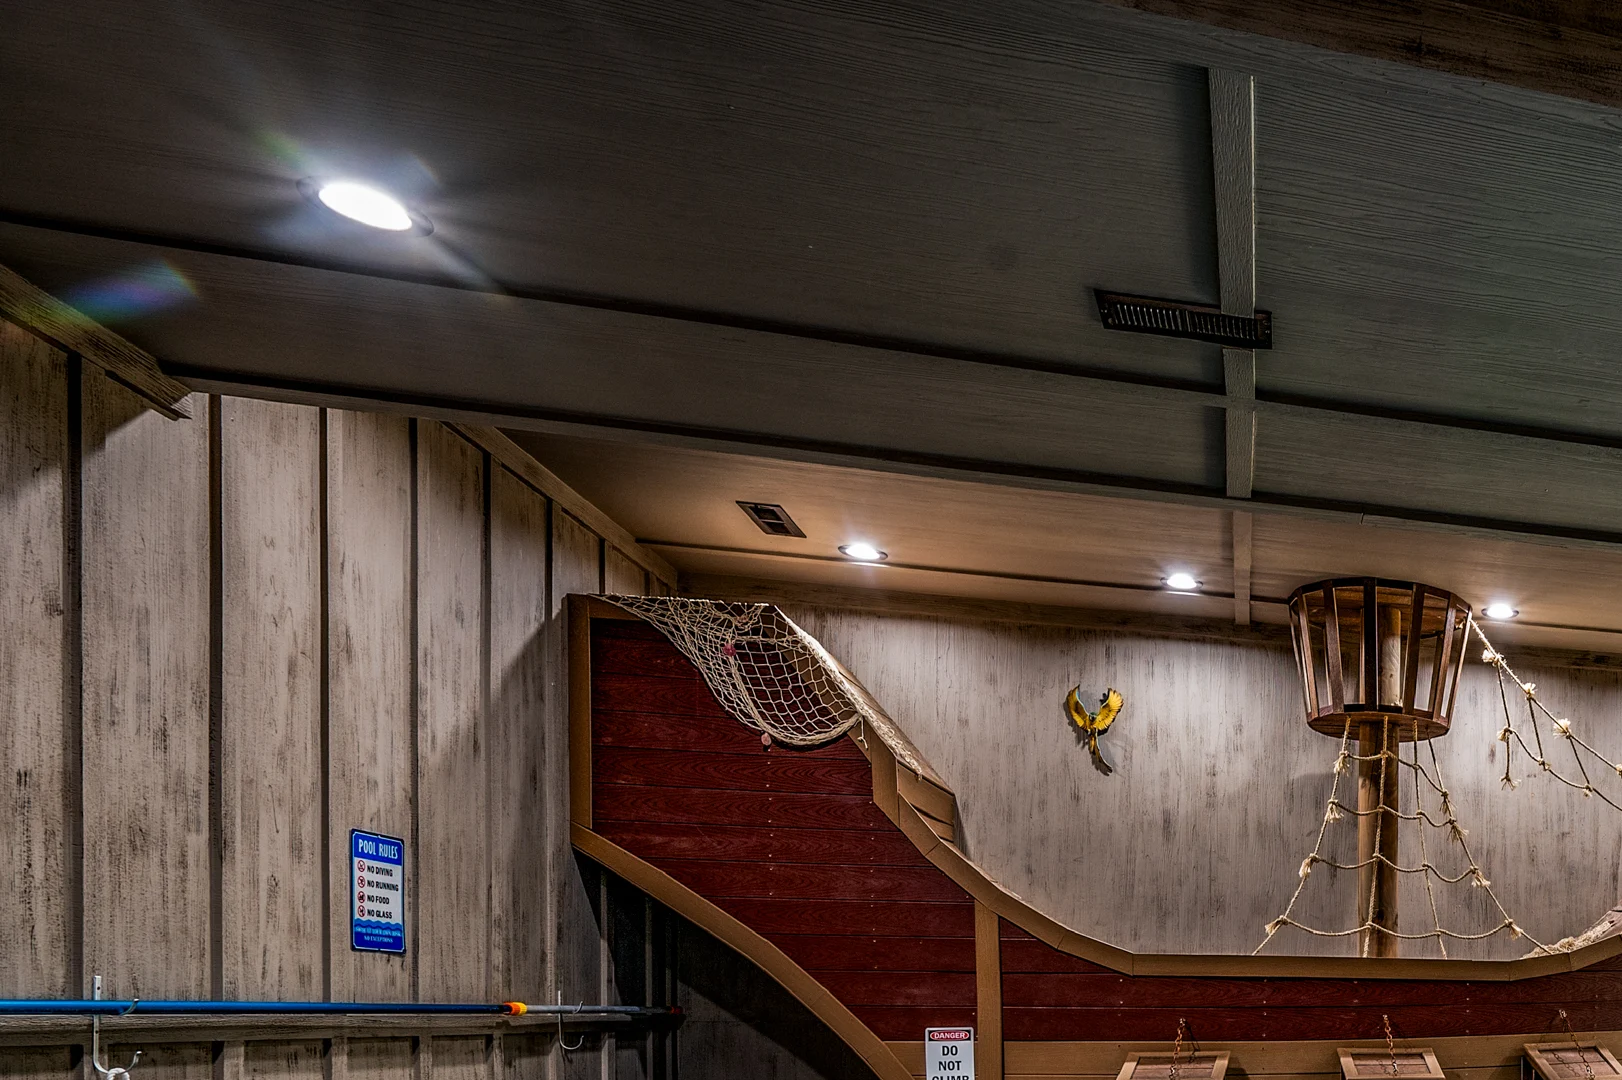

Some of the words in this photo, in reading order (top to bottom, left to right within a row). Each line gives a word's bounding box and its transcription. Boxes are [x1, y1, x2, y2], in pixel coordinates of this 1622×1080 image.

[358, 839, 376, 855] POOL
[379, 843, 398, 859] RULES
[366, 865, 375, 874] NO
[375, 866, 393, 877] DIVING
[366, 880, 375, 888] NO
[375, 881, 399, 892] RUNNING
[366, 895, 375, 903] NO
[375, 895, 390, 905] FOOD
[366, 909, 375, 917] NO
[375, 910, 392, 919] GLASS
[942, 1045, 958, 1056] DO
[938, 1060, 962, 1071] NOT
